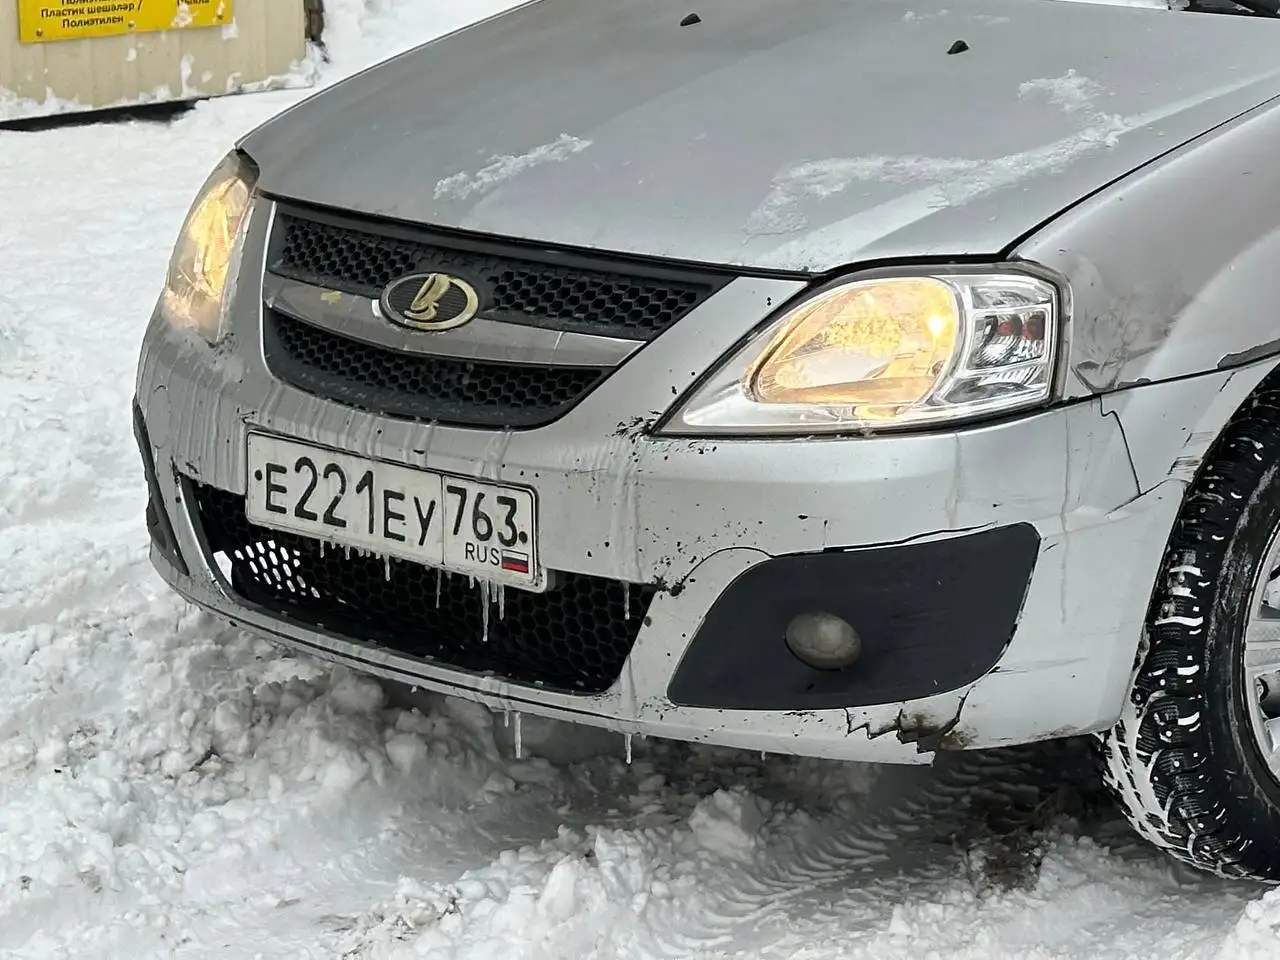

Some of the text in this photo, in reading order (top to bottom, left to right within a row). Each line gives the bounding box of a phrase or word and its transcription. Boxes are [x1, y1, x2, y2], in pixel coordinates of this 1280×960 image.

[41, 7, 84, 18] Пластик
[62, 16, 124, 28] Полиэтилен
[465, 541, 500, 566] RUS
